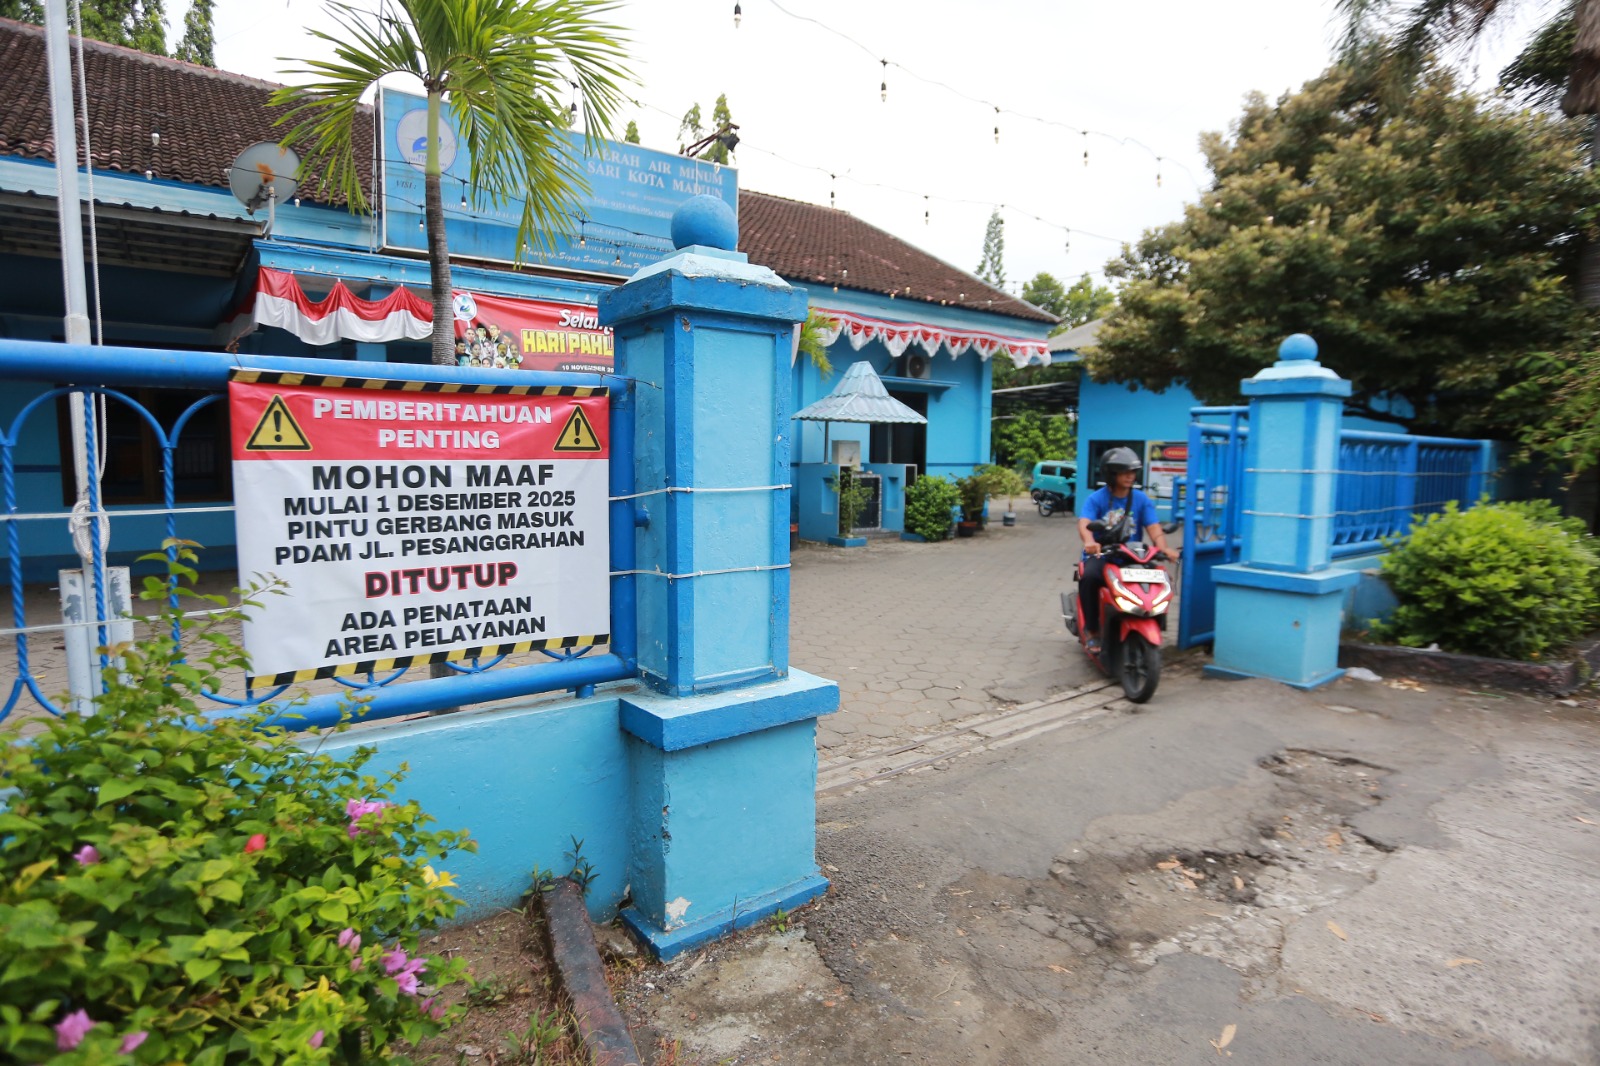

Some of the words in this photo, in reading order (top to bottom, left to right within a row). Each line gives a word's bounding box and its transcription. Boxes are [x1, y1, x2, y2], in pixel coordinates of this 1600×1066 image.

[587, 161, 620, 179] SARI
[628, 169, 665, 189] KOTA
[648, 160, 672, 175] AIR
[680, 165, 723, 186] MINUM
[558, 309, 614, 335] Sela
[522, 330, 566, 354] HARI
[567, 331, 614, 357] PAHL
[571, 364, 606, 373] NOVEMBER
[313, 398, 552, 424] PEMBERITAHUAN
[378, 429, 500, 449] PENTING
[312, 465, 452, 490] MOHON
[466, 464, 554, 488] MAAF
[284, 495, 369, 516] MULAI
[376, 495, 391, 513] 1
[397, 492, 522, 512] DESEMBER
[527, 490, 576, 508] 2025
[288, 518, 369, 540] PINTU
[376, 514, 492, 535] GERBANG
[497, 510, 575, 530] MASUK
[275, 542, 353, 566] PDAM
[358, 541, 395, 560] JL.
[401, 530, 585, 557] PESANGGRAHAN
[365, 561, 518, 599] DITUTUP
[340, 609, 397, 632] ADA
[403, 596, 532, 626] PENATAAN
[324, 633, 398, 658] AREA
[404, 616, 546, 649] PELAYANAN
